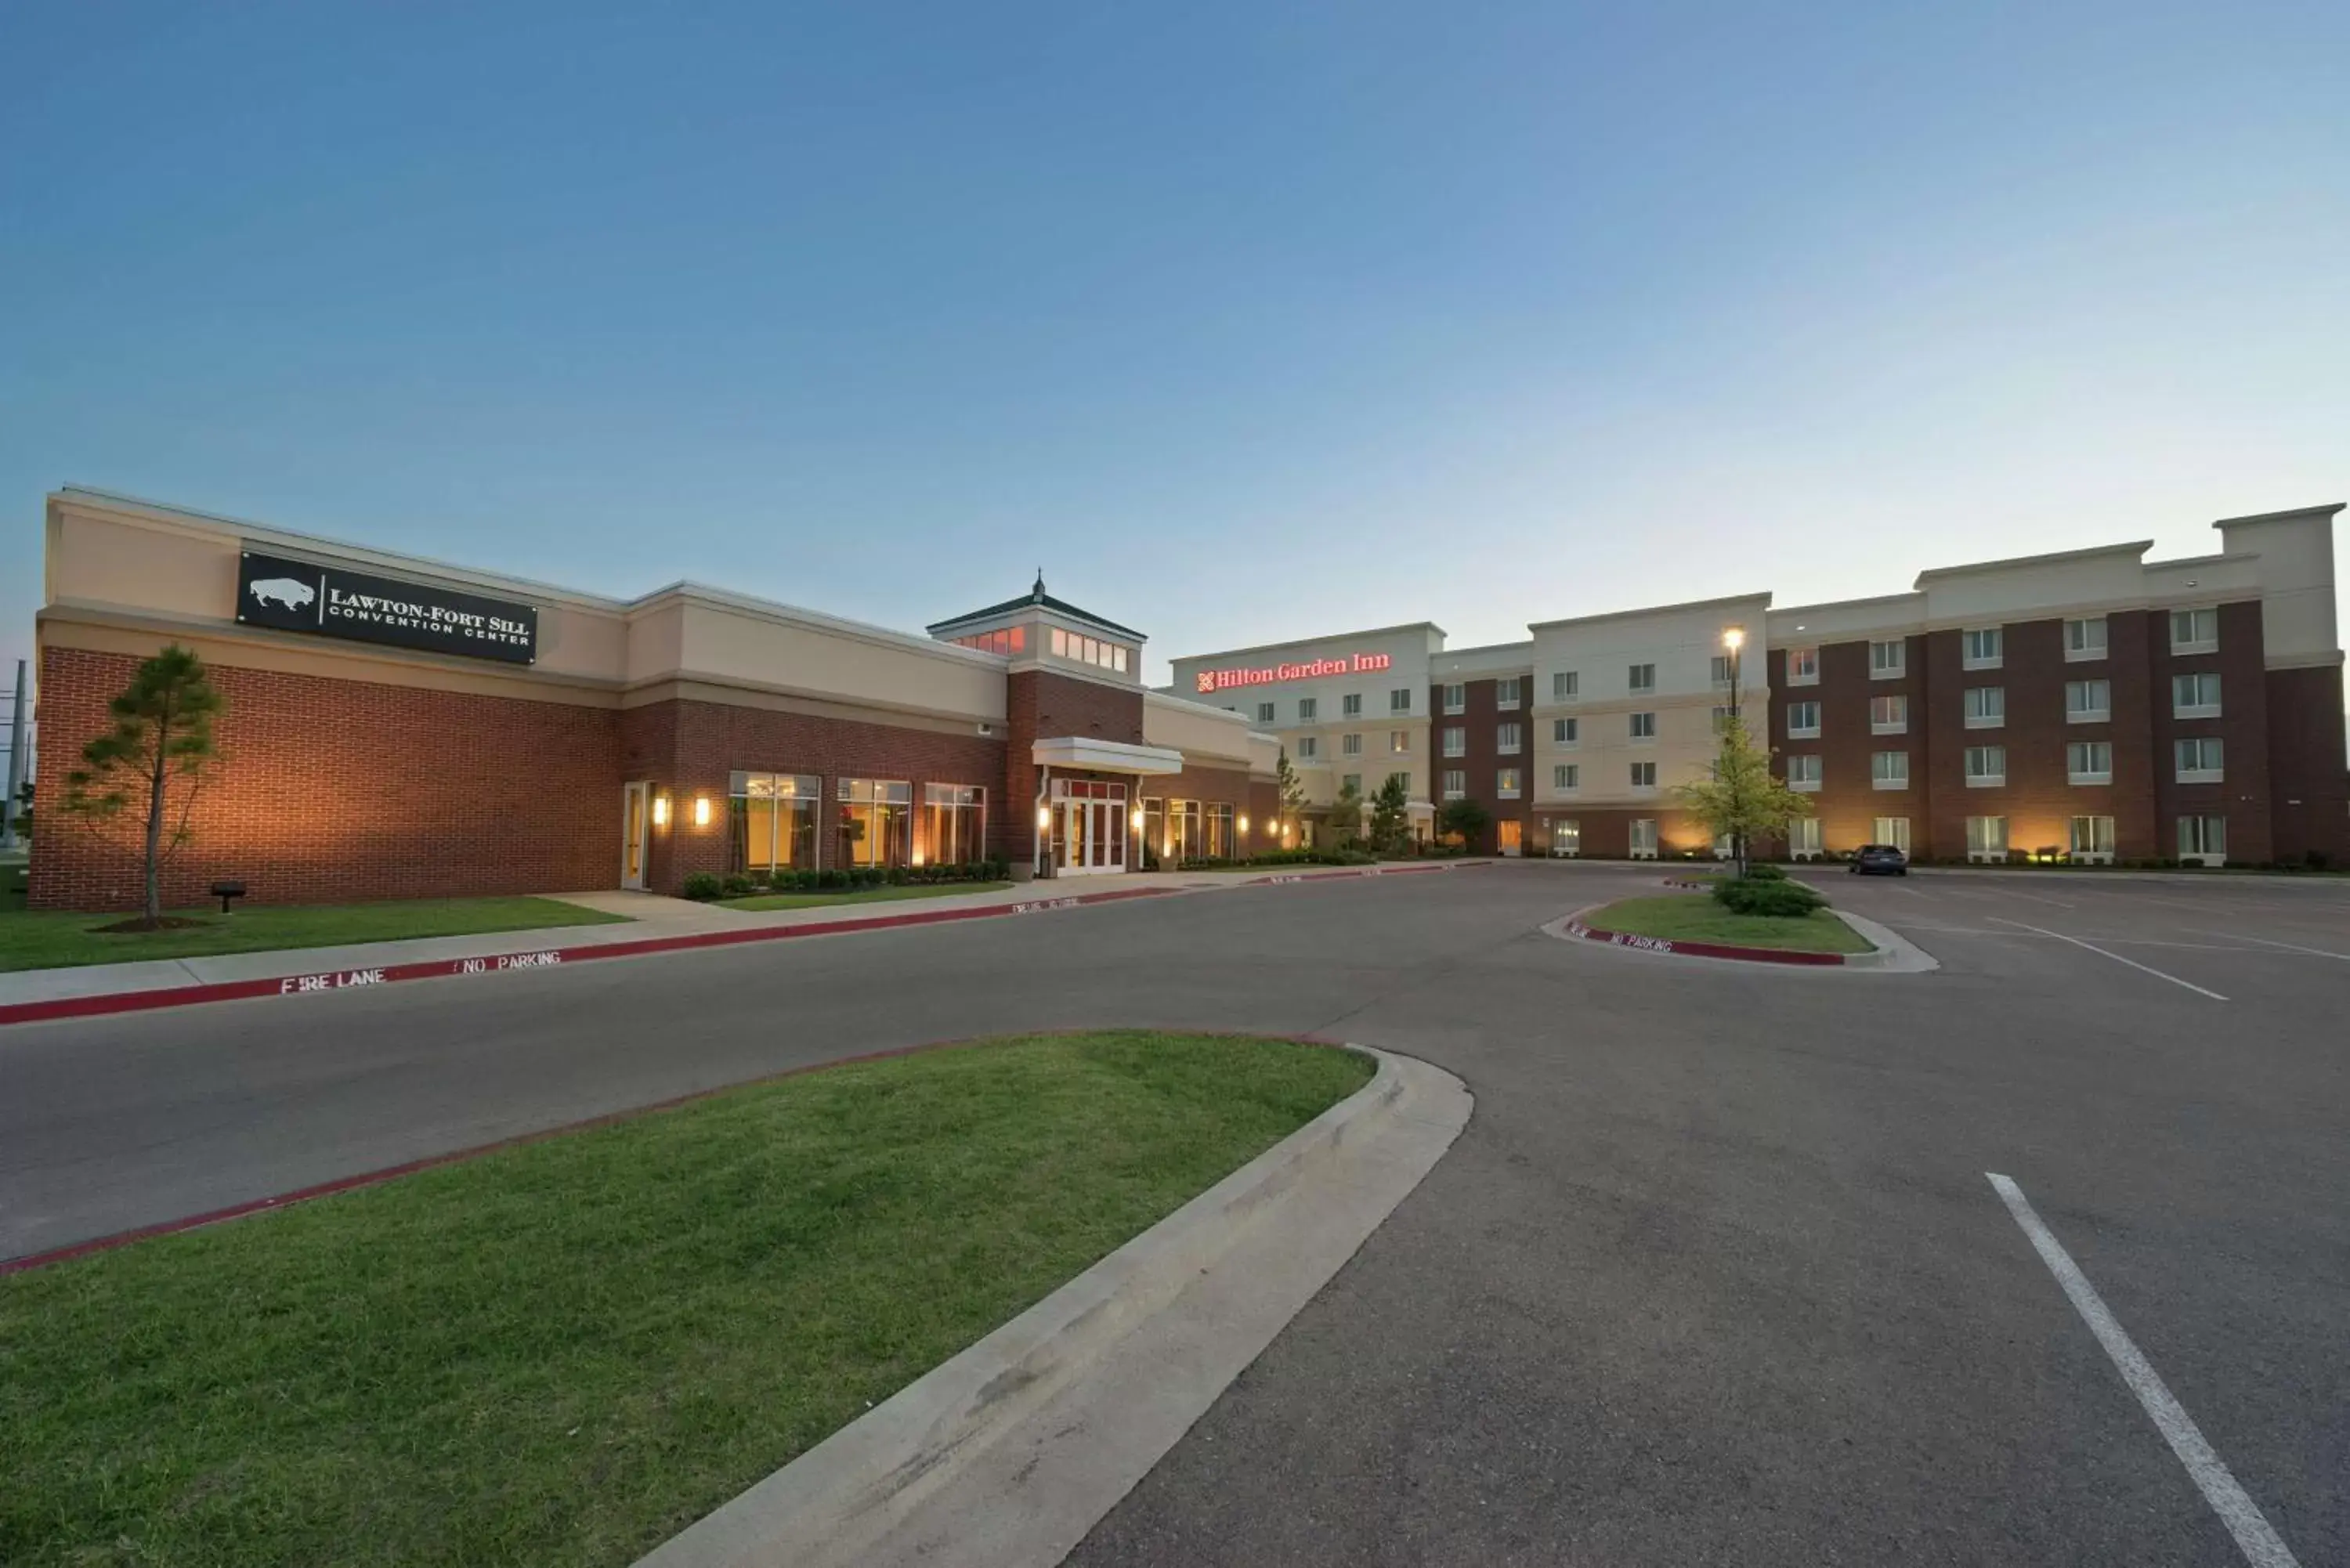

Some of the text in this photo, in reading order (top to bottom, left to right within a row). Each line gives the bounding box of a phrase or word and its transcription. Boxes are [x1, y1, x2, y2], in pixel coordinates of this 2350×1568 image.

[328, 605, 529, 646] CONVENTION CENTER
[330, 588, 529, 636] LAWTON-FORT SILL
[1217, 652, 1389, 688] Hilton Garden Inn
[1628, 934, 1673, 952] PARKING
[462, 952, 561, 974] NO PARKING
[281, 968, 386, 994] FIRE LANE
